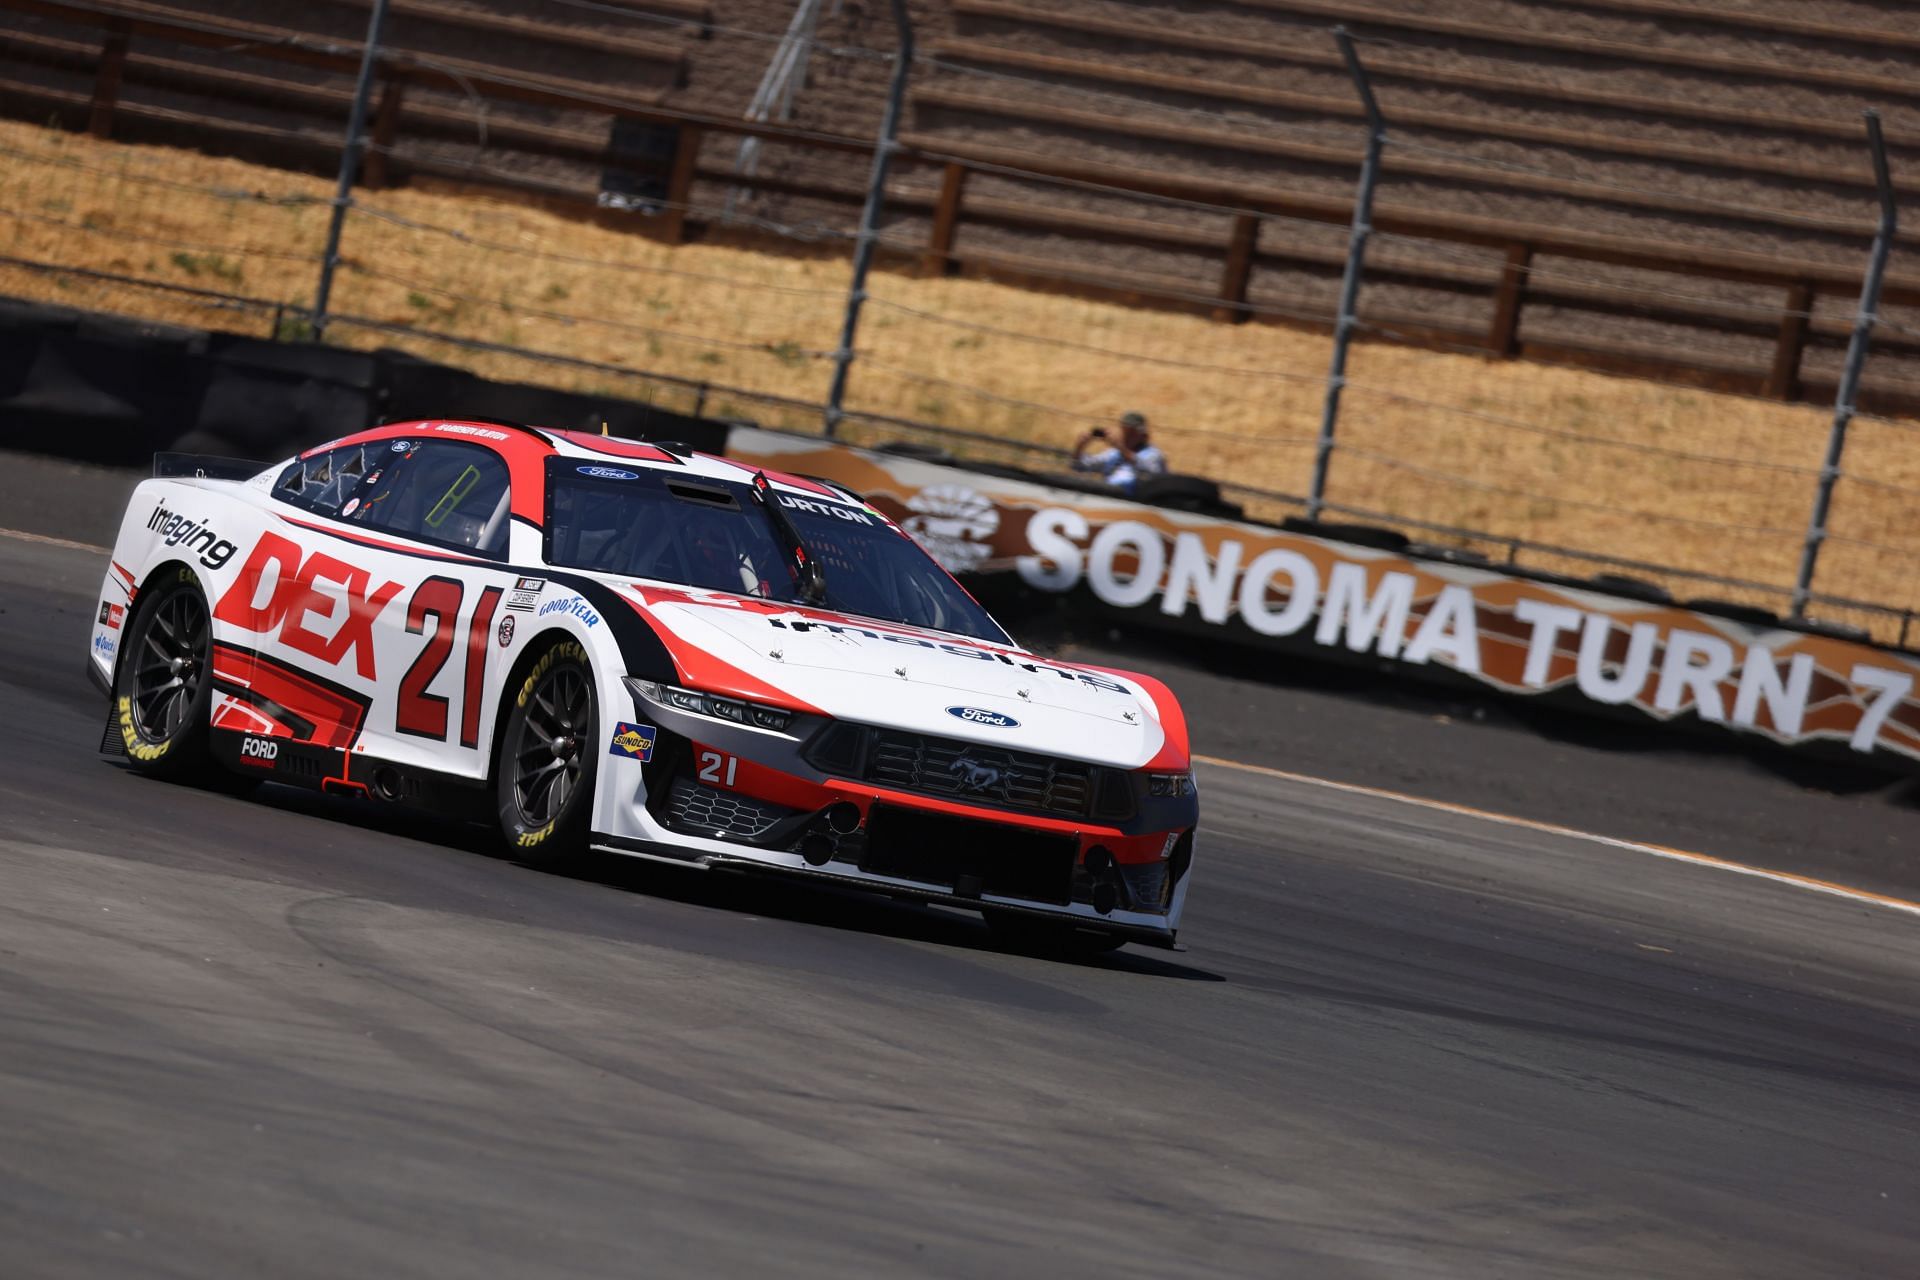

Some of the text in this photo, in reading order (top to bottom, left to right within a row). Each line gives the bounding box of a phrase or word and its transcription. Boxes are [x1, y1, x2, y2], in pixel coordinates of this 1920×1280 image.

[590, 467, 626, 478] Ford
[776, 494, 875, 527] URTON
[147, 497, 239, 570] imaging
[212, 530, 406, 682] DEX
[539, 597, 599, 628] GOODYEAR
[1016, 507, 1913, 753] SONOMA TURN 7
[395, 574, 505, 750] 21
[961, 708, 1007, 726] Ford
[241, 737, 278, 760] FORD
[615, 735, 651, 749] SUNOCO
[700, 751, 737, 786] 21
